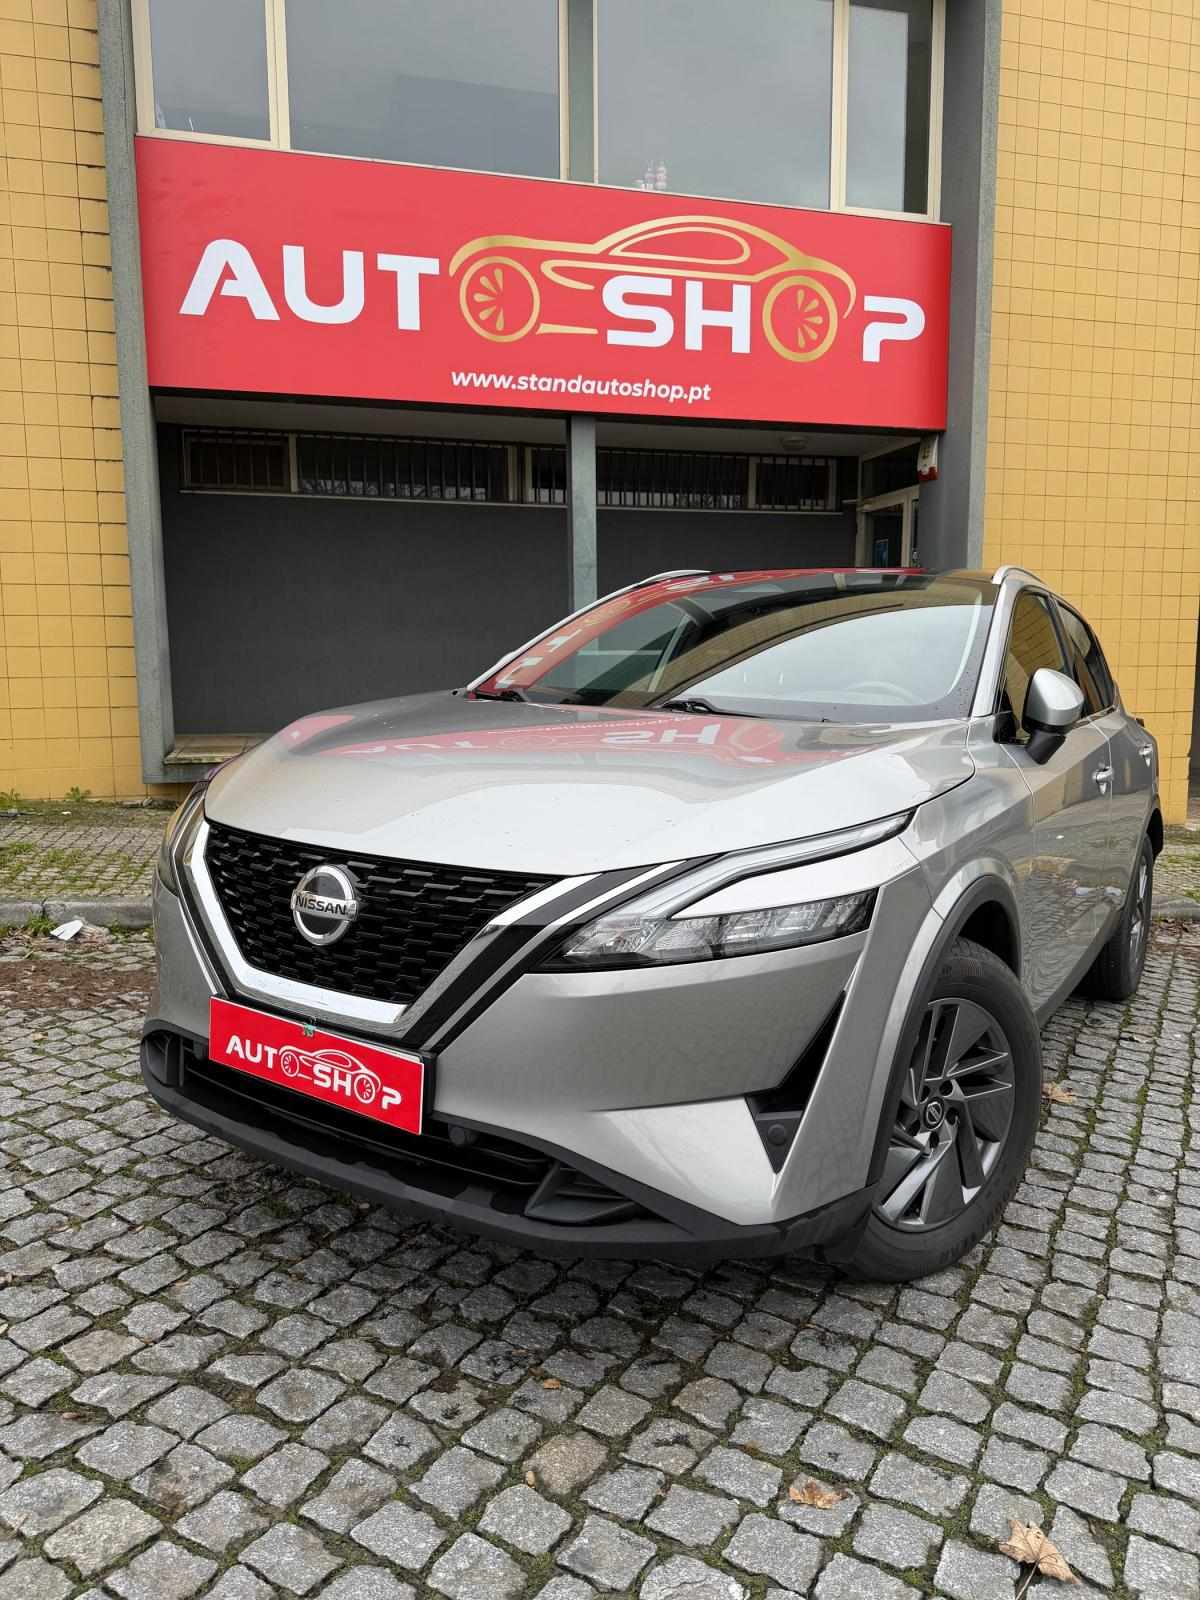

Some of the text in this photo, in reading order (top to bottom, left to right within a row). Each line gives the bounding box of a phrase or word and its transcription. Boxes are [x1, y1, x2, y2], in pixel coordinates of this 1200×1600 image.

[179, 239, 926, 365] AUTO SHOP
[451, 370, 712, 403] www.standautoshop.pt
[295, 896, 348, 916] NISSAN
[225, 1035, 402, 1110] AUTO SHOP
